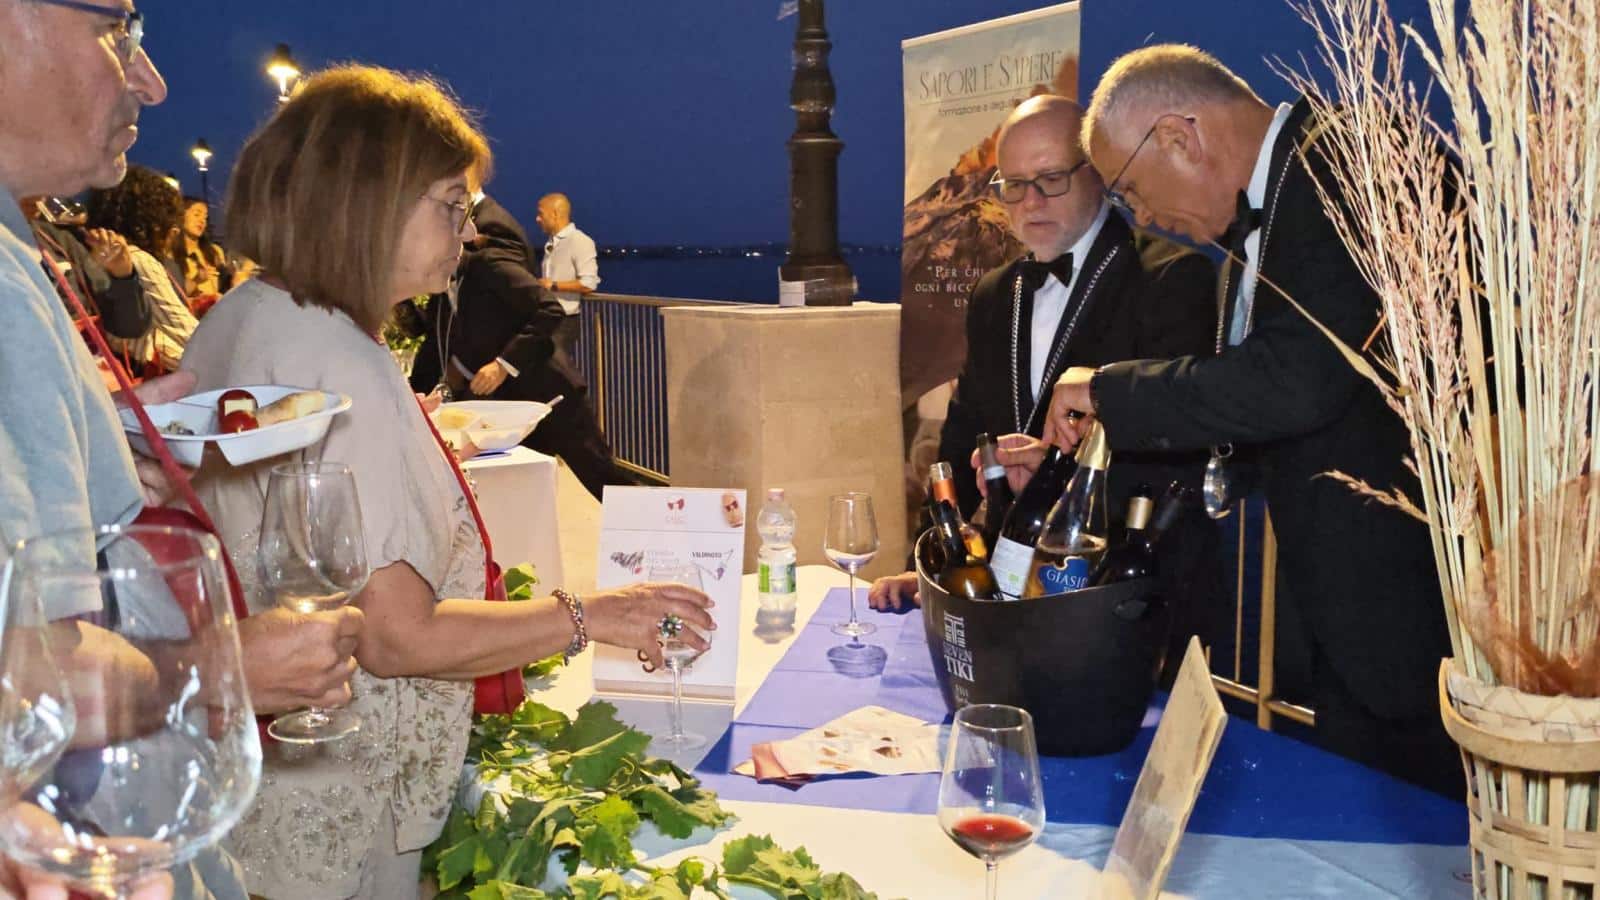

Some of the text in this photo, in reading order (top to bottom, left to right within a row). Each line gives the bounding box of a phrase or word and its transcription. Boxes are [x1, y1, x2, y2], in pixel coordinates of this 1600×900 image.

[919, 50, 1063, 99] SAPORI E SAPERE
[943, 653, 976, 682] TIKI
